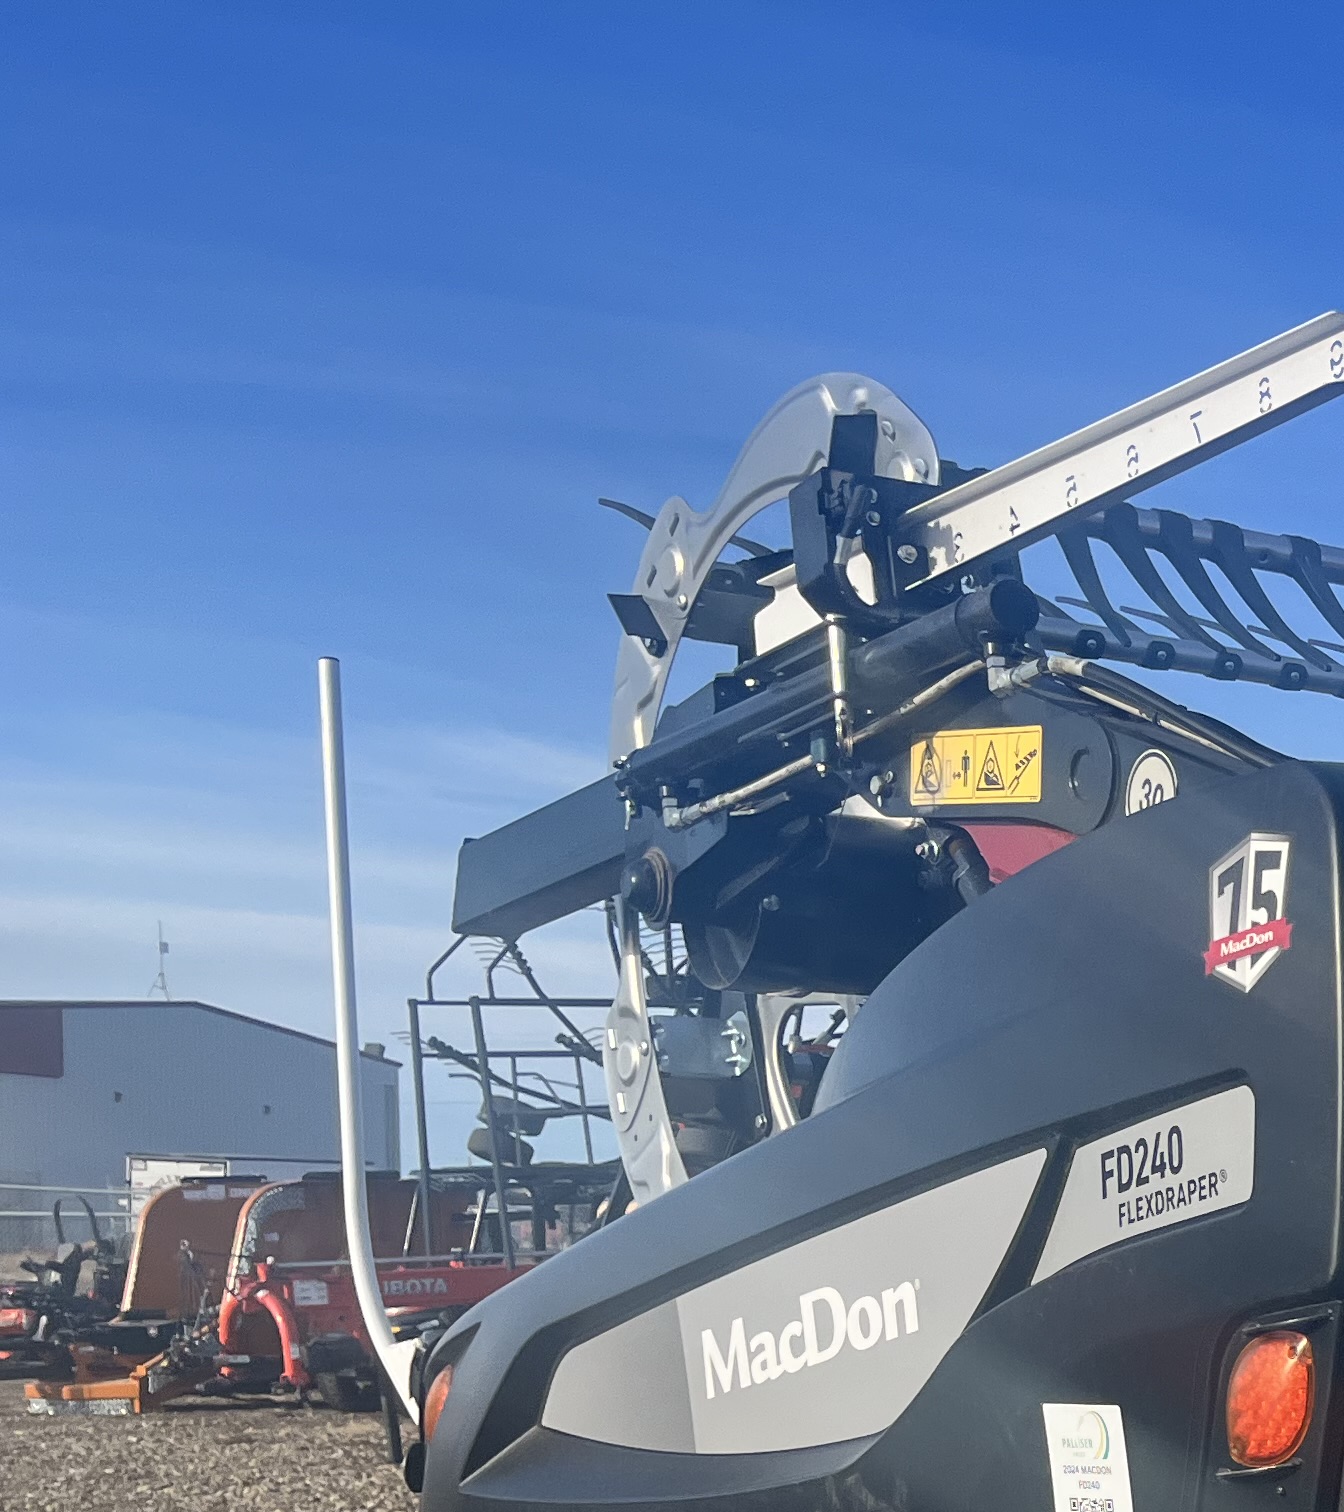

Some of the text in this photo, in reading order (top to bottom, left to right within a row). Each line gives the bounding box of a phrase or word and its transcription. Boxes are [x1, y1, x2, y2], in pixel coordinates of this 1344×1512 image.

[1259, 377, 1272, 414] 8
[1218, 850, 1283, 972] 75
[1220, 930, 1274, 958] MacDon
[1101, 1125, 1184, 1200] FD240
[701, 1280, 920, 1400] MacDon
